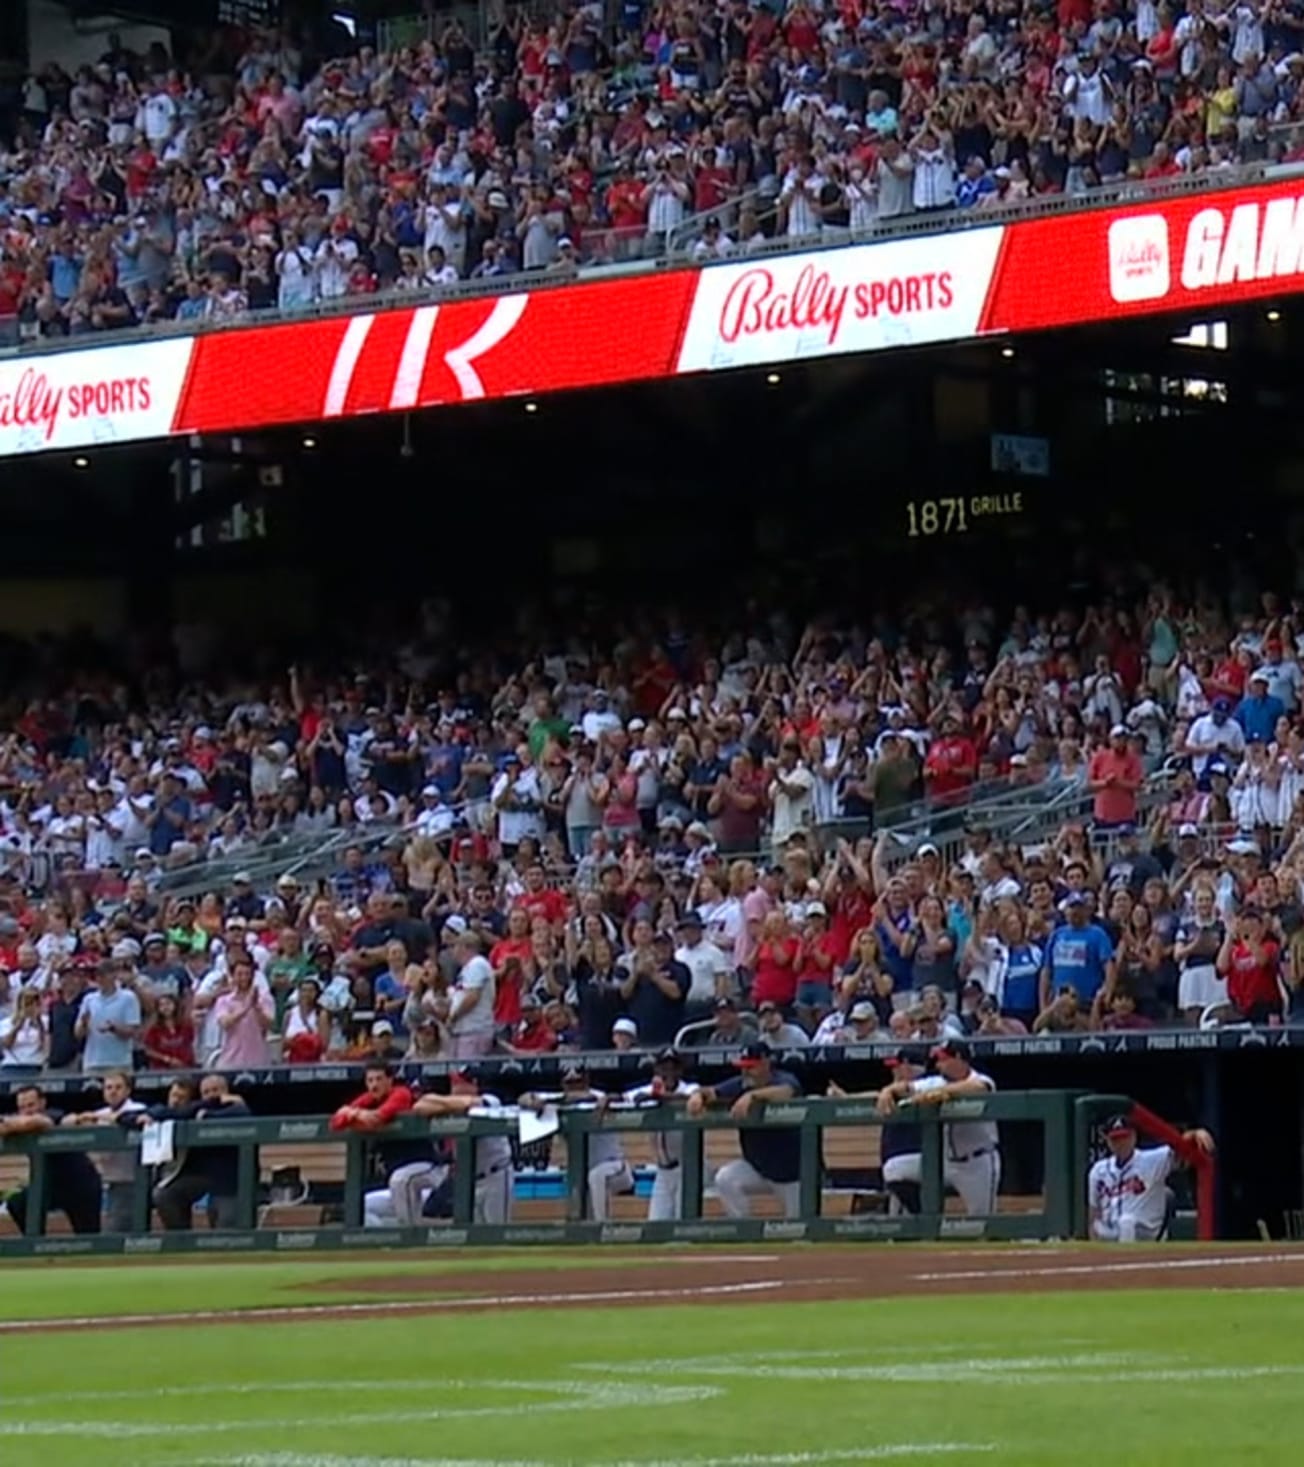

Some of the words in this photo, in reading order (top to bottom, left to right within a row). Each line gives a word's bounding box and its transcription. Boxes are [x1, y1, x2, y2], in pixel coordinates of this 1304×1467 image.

[718, 263, 849, 346] Bally
[855, 271, 954, 319] SPORTS
[68, 376, 151, 419] SPORTS
[907, 496, 968, 537] 1871
[970, 491, 1024, 516] GRILLE
